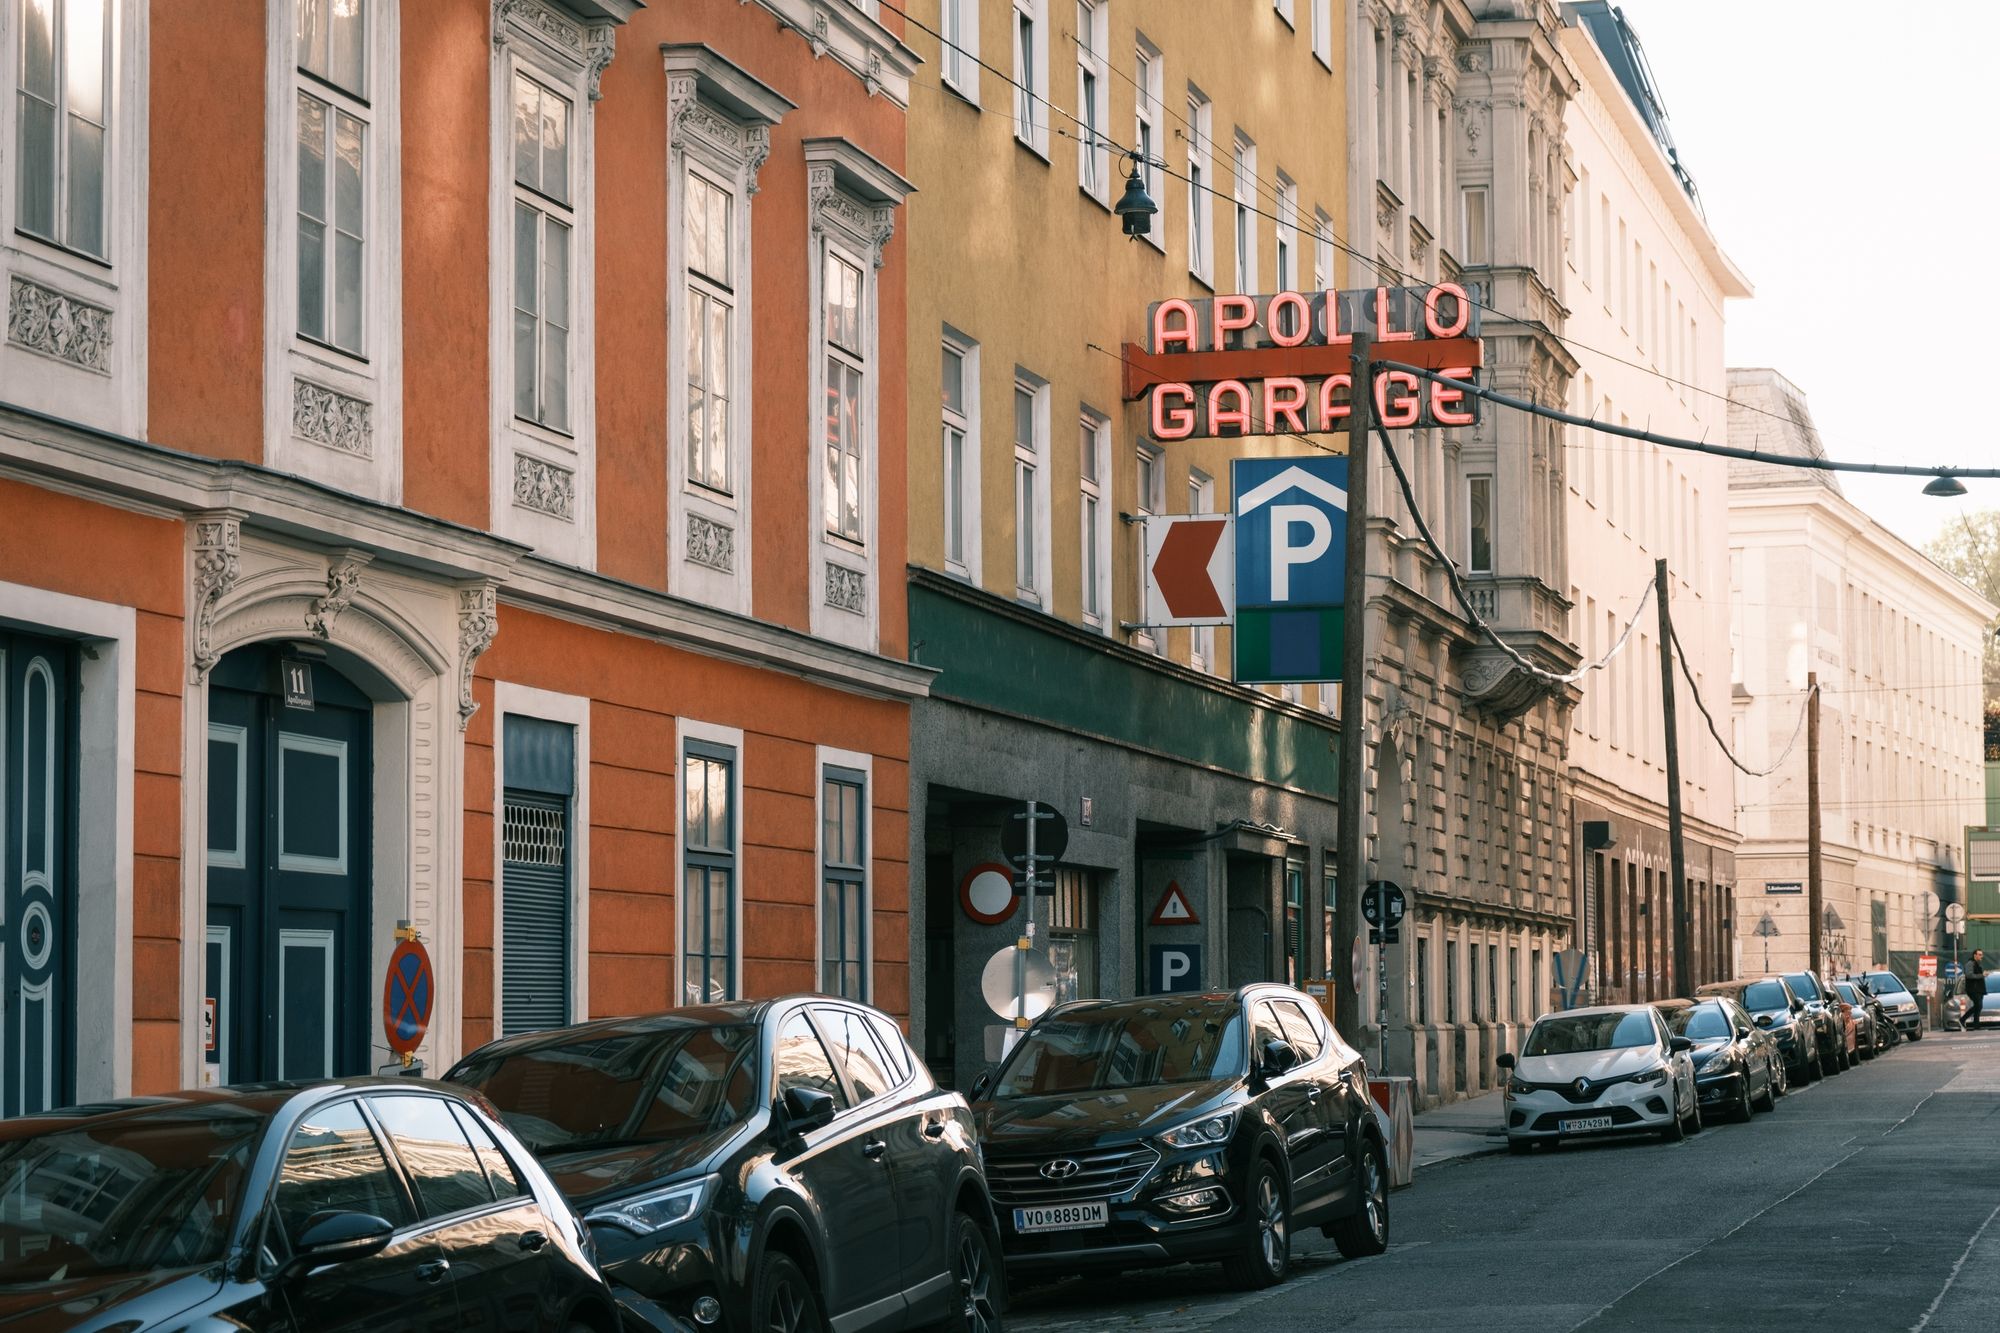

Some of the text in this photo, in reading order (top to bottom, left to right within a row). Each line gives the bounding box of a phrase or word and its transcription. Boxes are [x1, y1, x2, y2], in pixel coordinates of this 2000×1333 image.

[1154, 282, 1470, 354] APOLLO
[1152, 367, 1476, 439] GARAGE
[1270, 504, 1332, 602] P
[290, 667, 305, 694] 11
[1162, 951, 1190, 991] P
